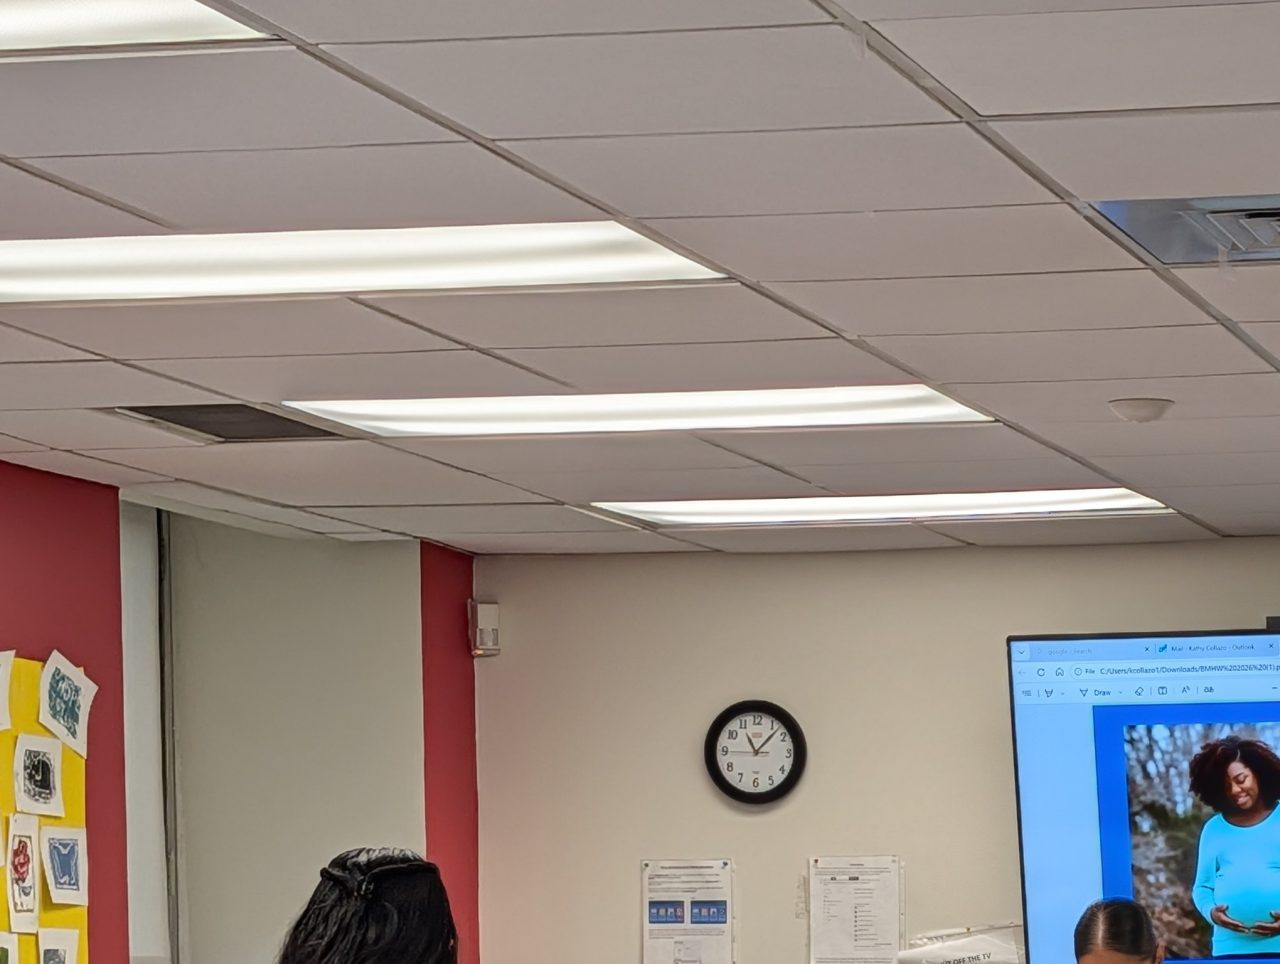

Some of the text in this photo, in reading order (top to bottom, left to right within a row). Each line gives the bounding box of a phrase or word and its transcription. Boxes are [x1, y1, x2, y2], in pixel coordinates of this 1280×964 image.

[739, 720, 747, 729] 11
[752, 714, 762, 725] 12
[770, 720, 774, 730] 1
[728, 729, 738, 740] 10
[780, 732, 787, 742] 2
[721, 746, 728, 756] 9
[786, 748, 792, 758] 3
[726, 762, 734, 772] 8
[779, 764, 786, 774] 4
[738, 772, 744, 782] 7
[768, 776, 774, 785] 5
[752, 777, 759, 788] 6
[968, 954, 980, 963] THE
[982, 952, 992, 960] TV
